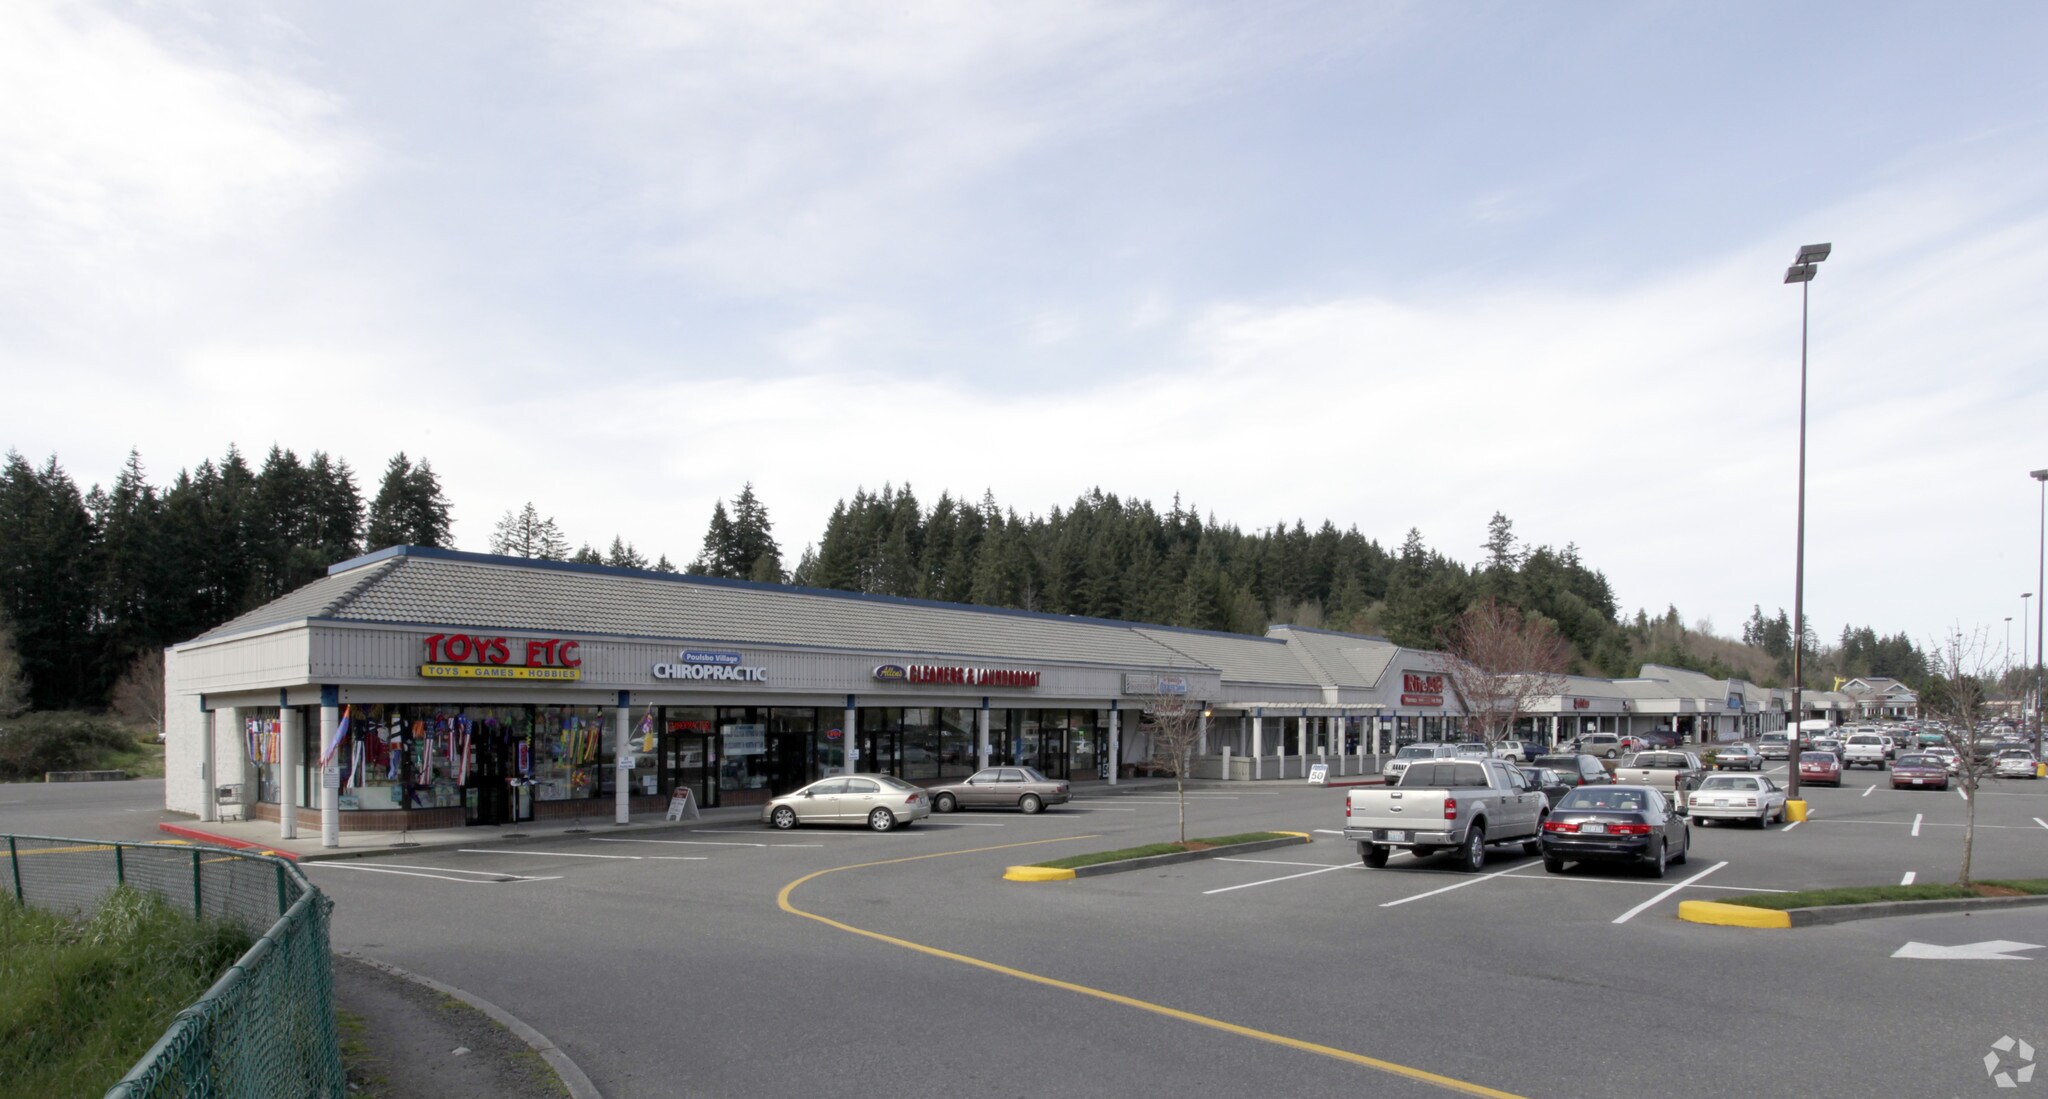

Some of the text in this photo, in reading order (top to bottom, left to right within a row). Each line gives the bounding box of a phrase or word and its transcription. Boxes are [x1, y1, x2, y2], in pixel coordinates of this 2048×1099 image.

[424, 633, 582, 667] TOYS ETC
[686, 653, 738, 664] Poulsbo Village
[428, 666, 575, 678] TOYS GAMES HOBBIES
[653, 663, 767, 681] CHIROPRACTIC
[908, 665, 1041, 687] CLEANERS & LAUNDROMAT
[1311, 771, 1324, 780] 50
